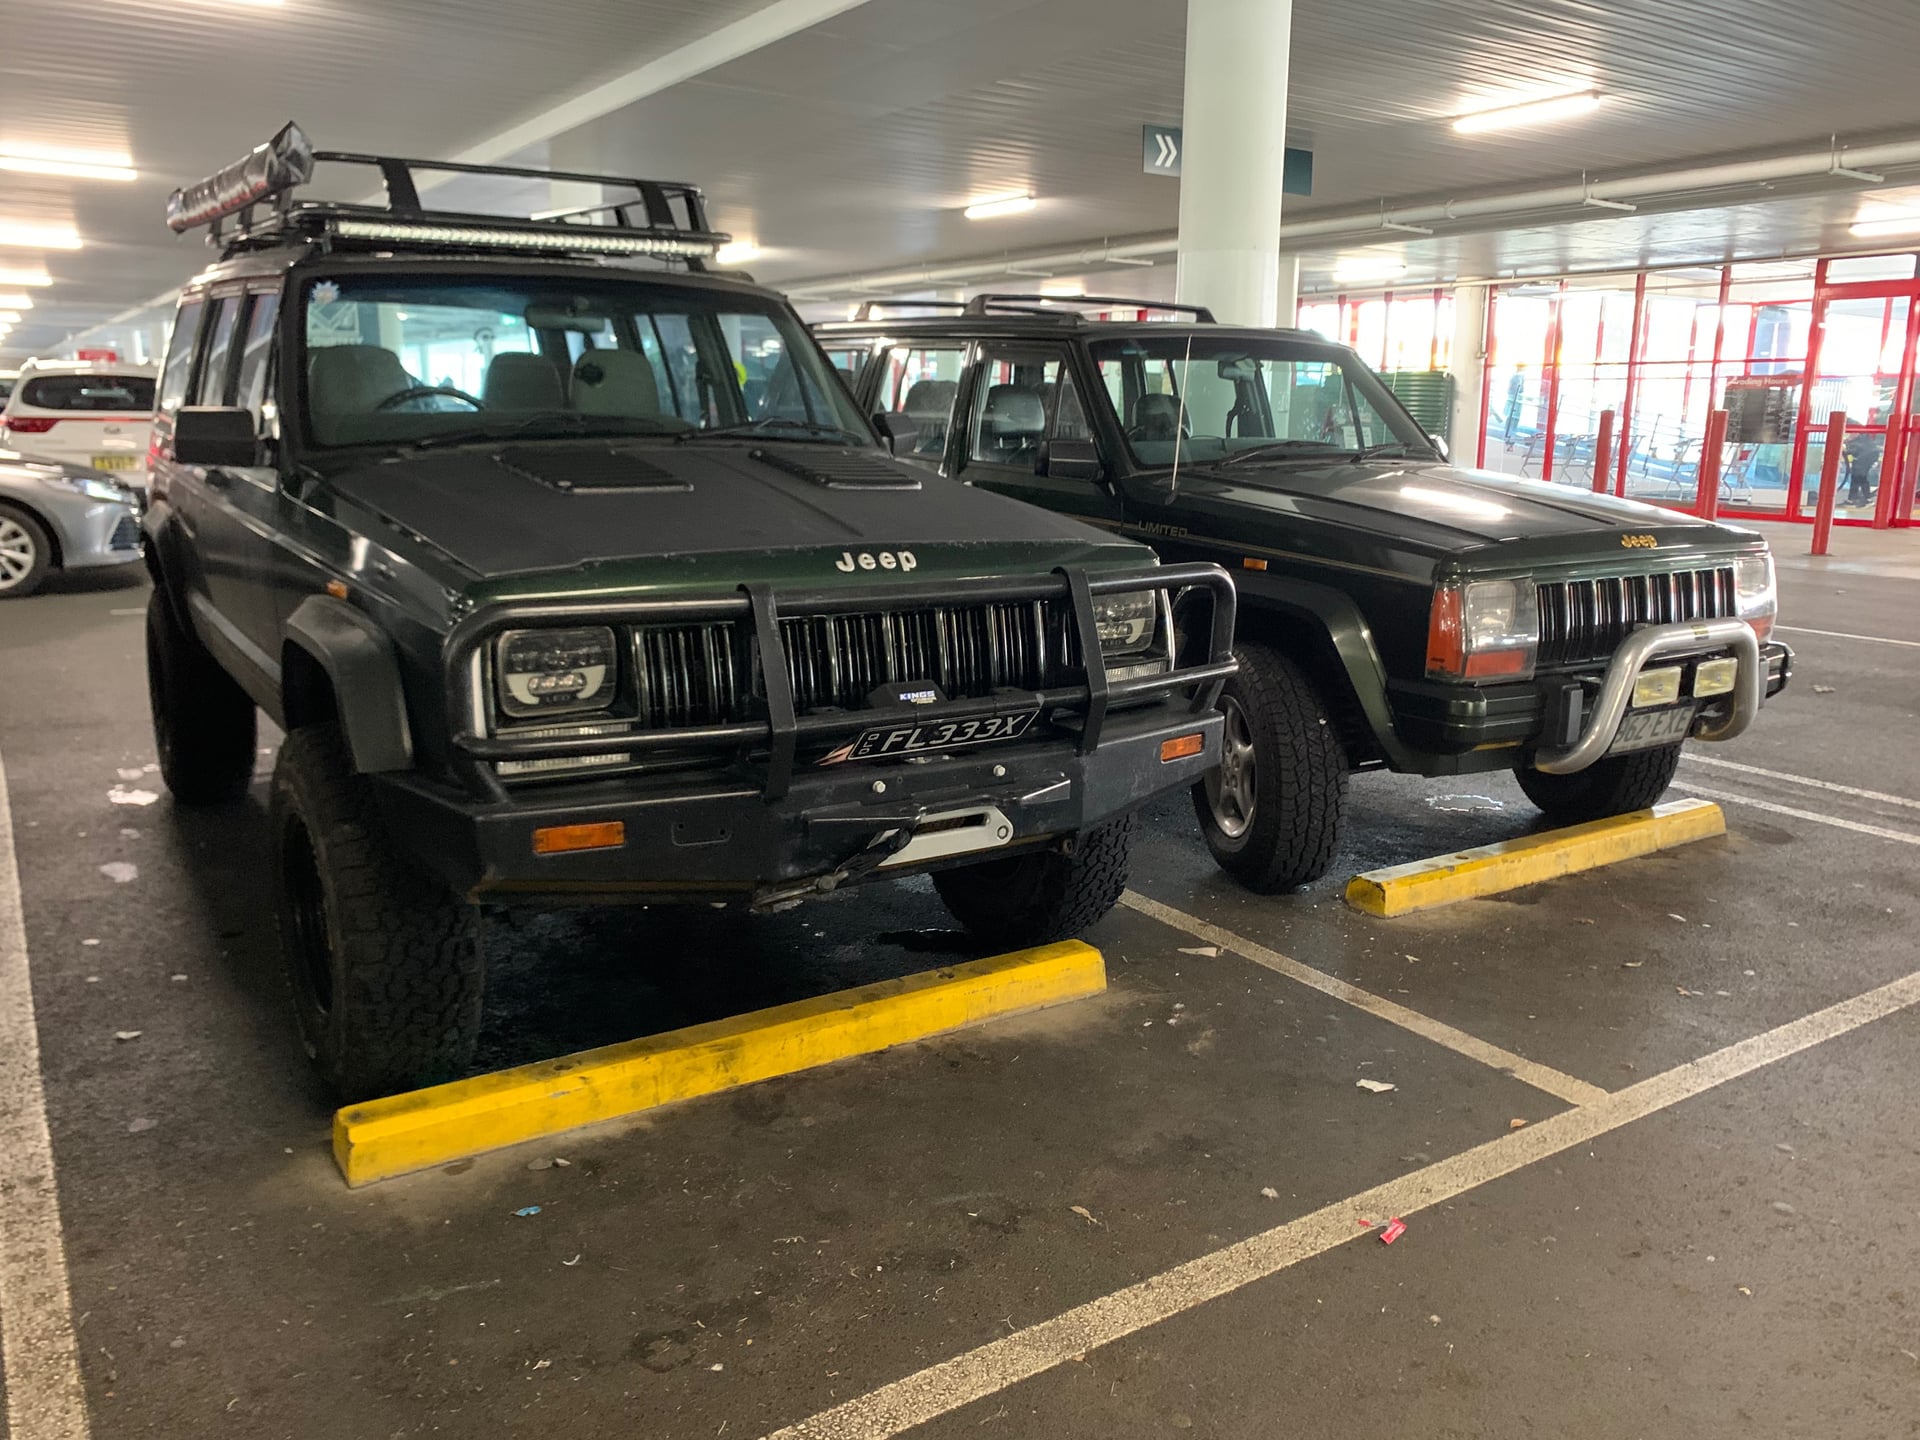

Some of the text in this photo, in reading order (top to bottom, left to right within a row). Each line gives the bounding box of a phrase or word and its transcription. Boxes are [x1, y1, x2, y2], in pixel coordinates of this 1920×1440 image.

[1138, 520, 1188, 537] LIMITED
[1621, 534, 1657, 548] Jeep
[836, 551, 918, 572] Jeep
[899, 690, 935, 700] KINGS
[1650, 707, 1693, 737] EXE
[881, 714, 1026, 751] FL333X
